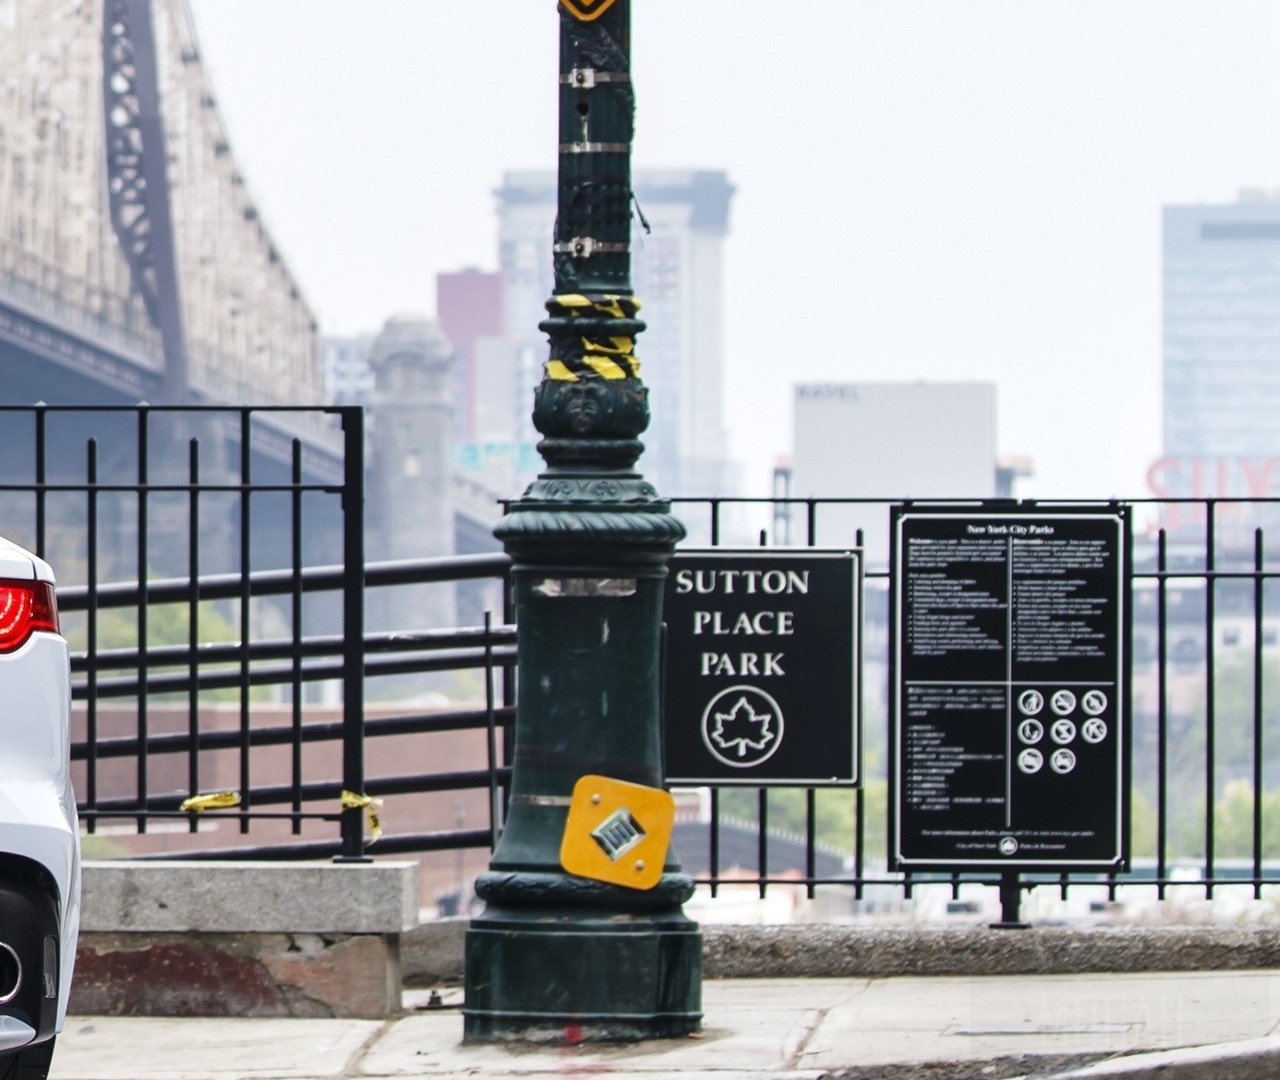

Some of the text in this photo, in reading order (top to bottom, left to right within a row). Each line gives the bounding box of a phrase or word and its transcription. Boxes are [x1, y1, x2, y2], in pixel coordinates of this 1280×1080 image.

[967, 524, 1055, 536] New York City Parks
[675, 569, 810, 595] SUTTON
[693, 610, 795, 635] PLACE
[700, 651, 786, 676] PARK
